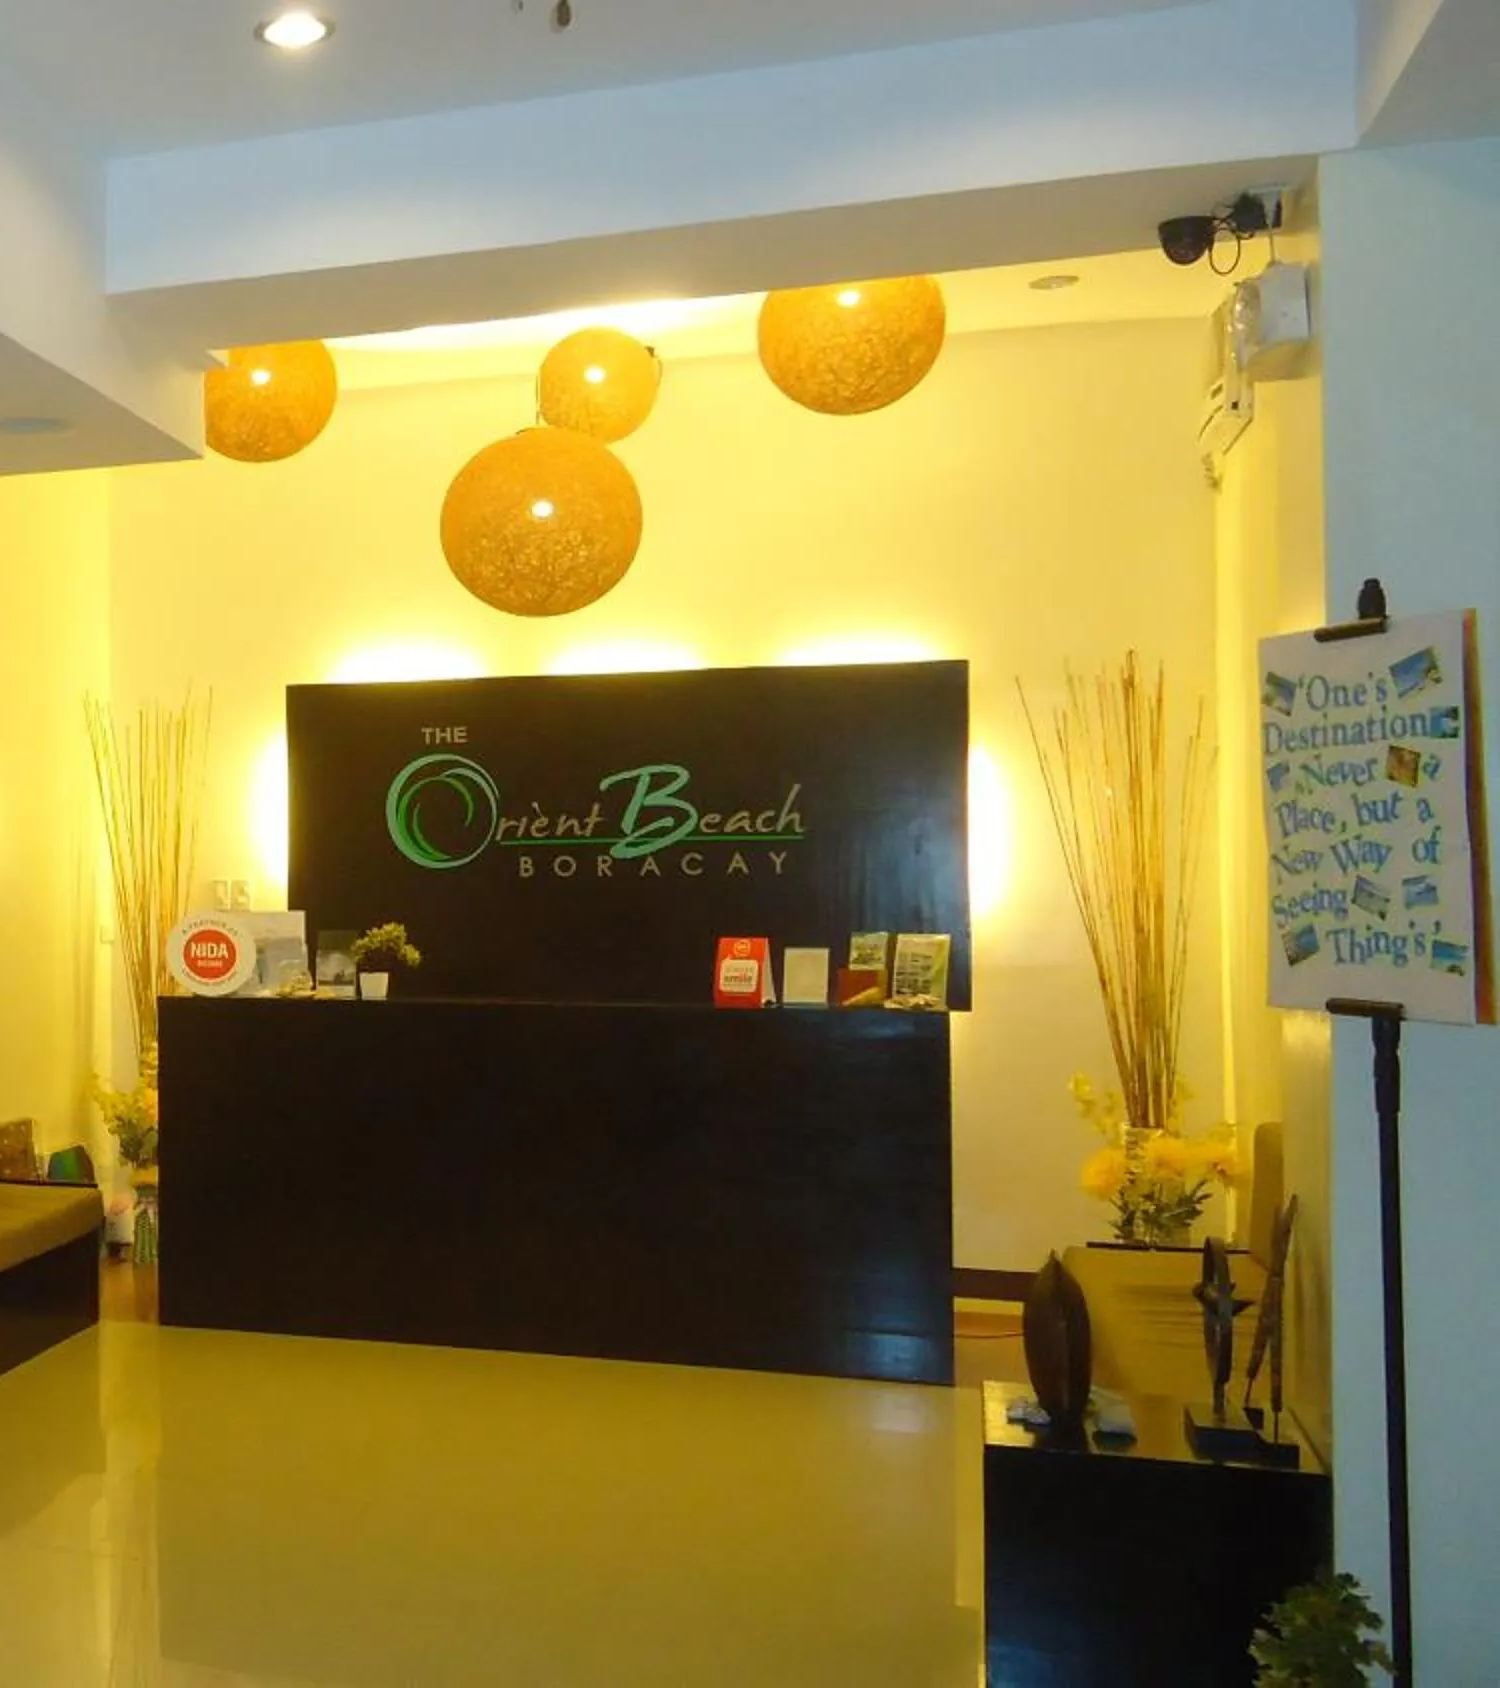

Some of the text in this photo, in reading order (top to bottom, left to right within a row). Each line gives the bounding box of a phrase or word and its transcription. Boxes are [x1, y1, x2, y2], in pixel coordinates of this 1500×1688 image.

[421, 725, 469, 744] THE
[1263, 705, 1428, 756] Destination
[1296, 753, 1441, 794] Never a
[599, 763, 805, 859] Beach
[1351, 791, 1402, 827] but
[1416, 798, 1434, 824] a
[518, 851, 788, 878] BORACAY
[1271, 826, 1442, 886] New Way of
[1271, 881, 1349, 929] Seeing
[191, 941, 229, 959] NIDA
